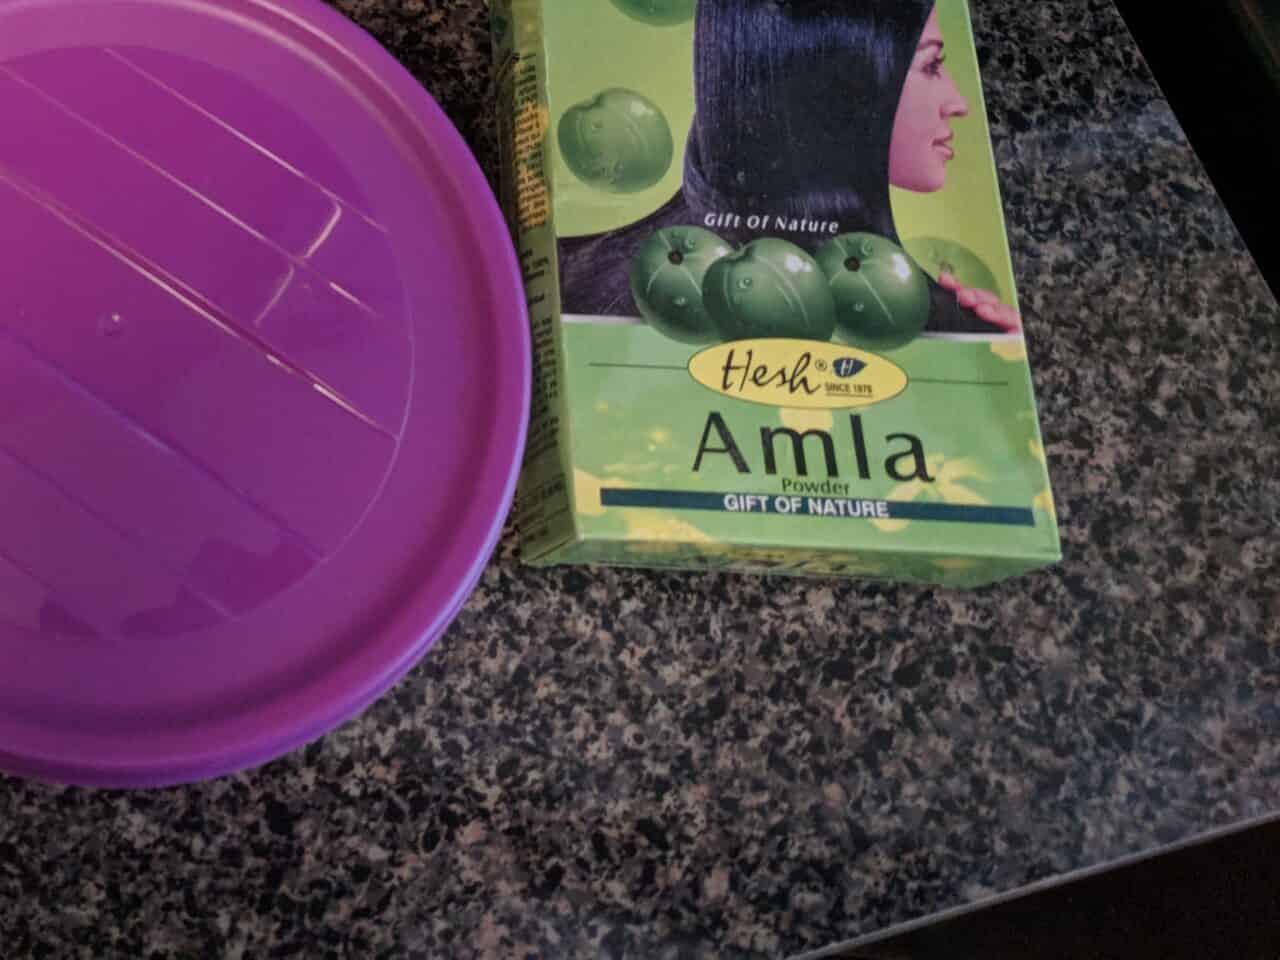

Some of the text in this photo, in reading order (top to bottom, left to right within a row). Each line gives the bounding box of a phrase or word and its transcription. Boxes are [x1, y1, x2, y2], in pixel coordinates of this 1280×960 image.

[703, 212, 840, 234] Gift Of Nature
[721, 348, 822, 396] Hesh
[692, 410, 936, 484] Amla
[781, 477, 851, 496] Powder
[723, 494, 890, 519] GIFT OF NATURE
